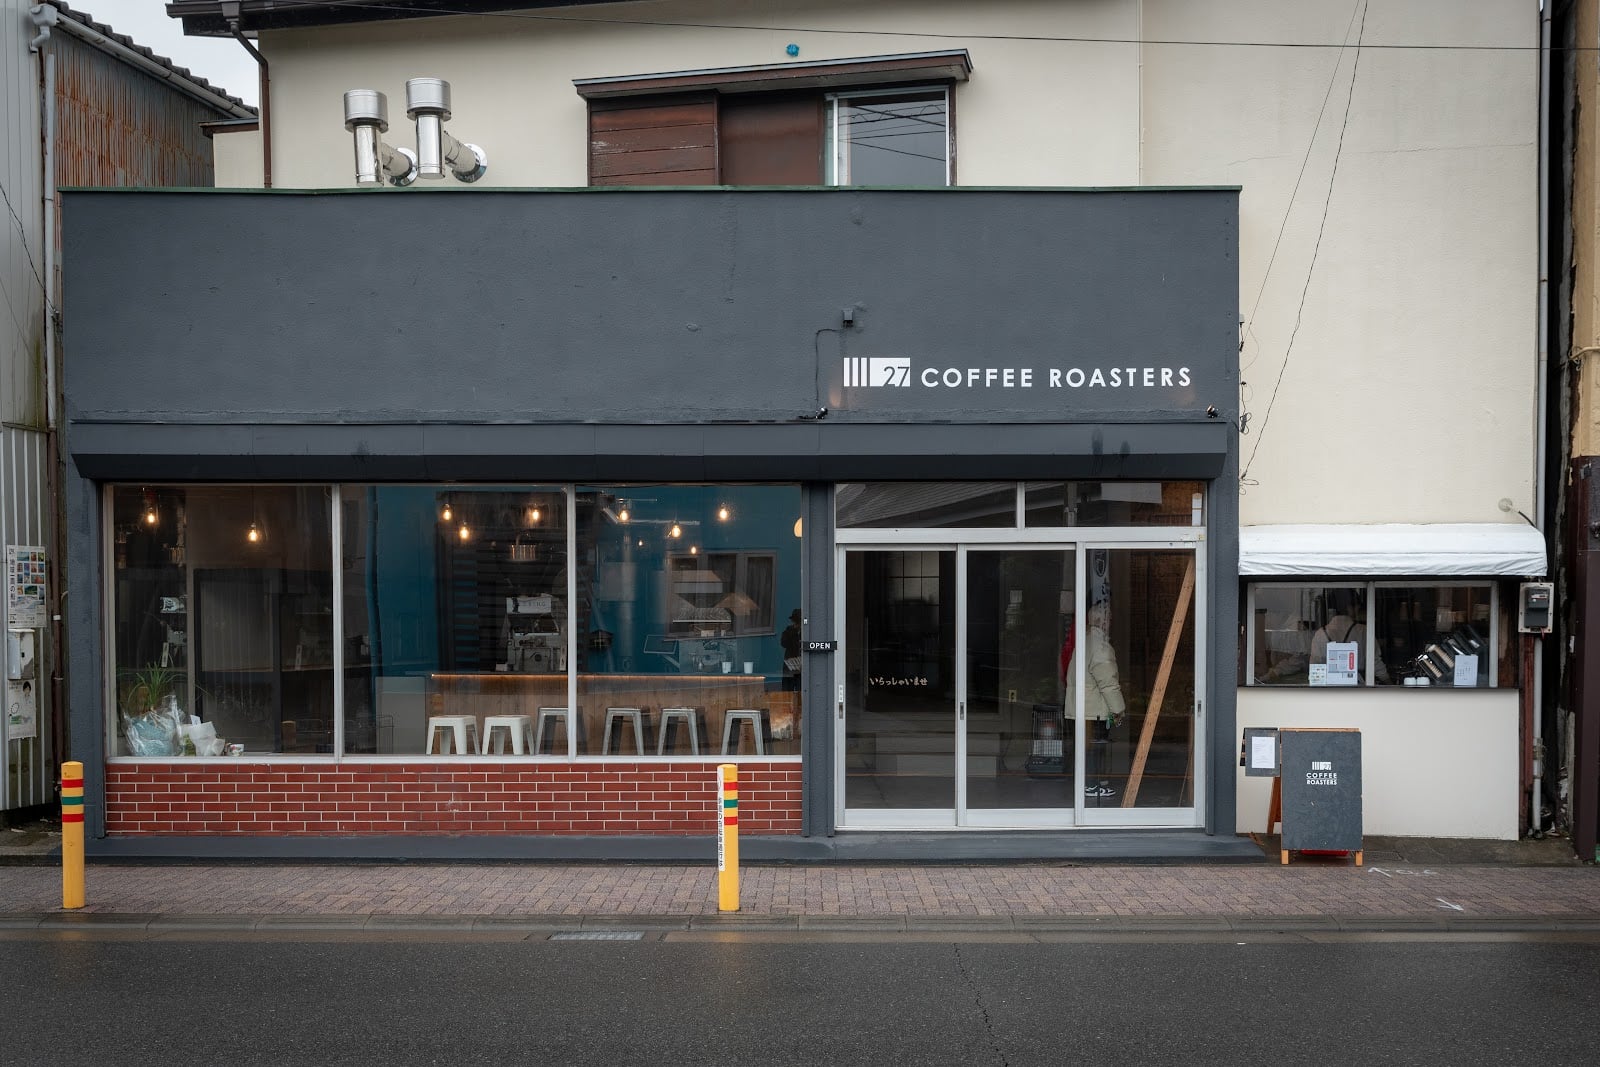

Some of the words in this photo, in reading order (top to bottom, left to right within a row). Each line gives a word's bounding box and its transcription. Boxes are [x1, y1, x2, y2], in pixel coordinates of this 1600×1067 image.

[883, 366, 910, 387] 27
[921, 367, 1033, 388] COFFEE
[1049, 367, 1191, 388] ROASTERS
[869, 676, 929, 686] いらっしゃいませ
